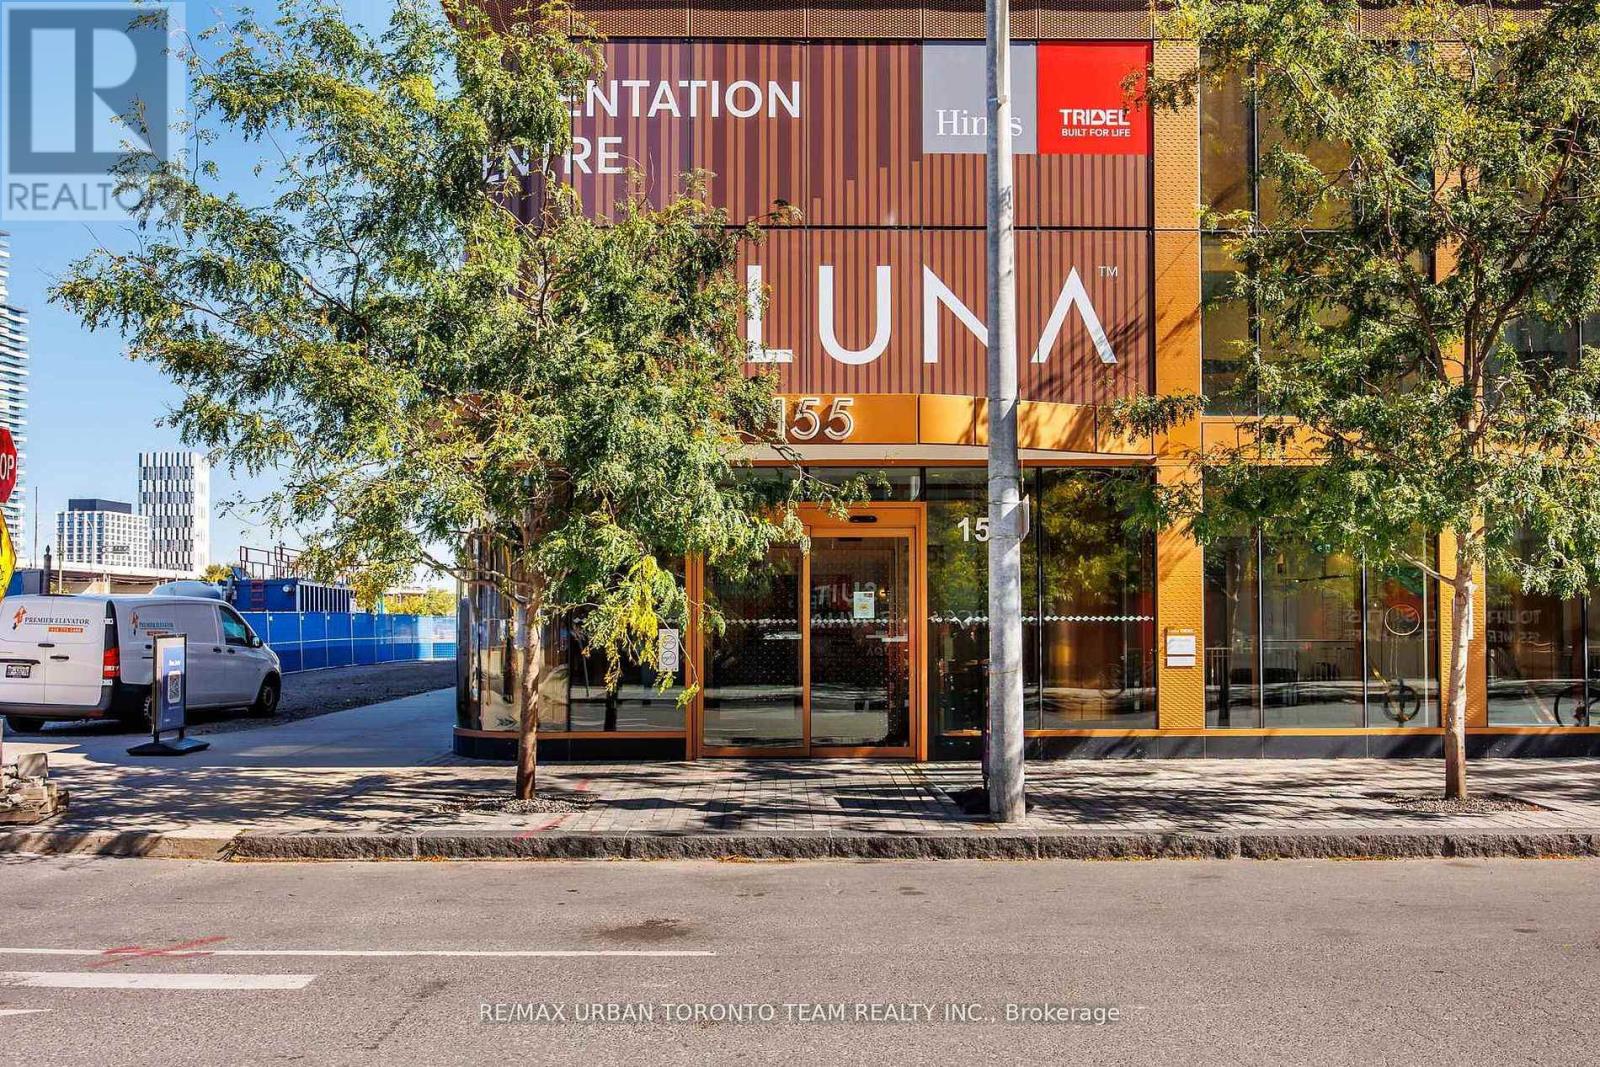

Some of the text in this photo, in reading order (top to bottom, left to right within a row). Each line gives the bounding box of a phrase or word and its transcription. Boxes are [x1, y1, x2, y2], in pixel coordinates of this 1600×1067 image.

[935, 108, 1023, 136] Hins
[1059, 108, 1131, 126] TRIDEL
[1062, 128, 1131, 138] BUILT FOR LIFE
[746, 264, 1118, 365] LUNA
[772, 397, 854, 441] 155
[54, 617, 90, 625] ELEVATOR
